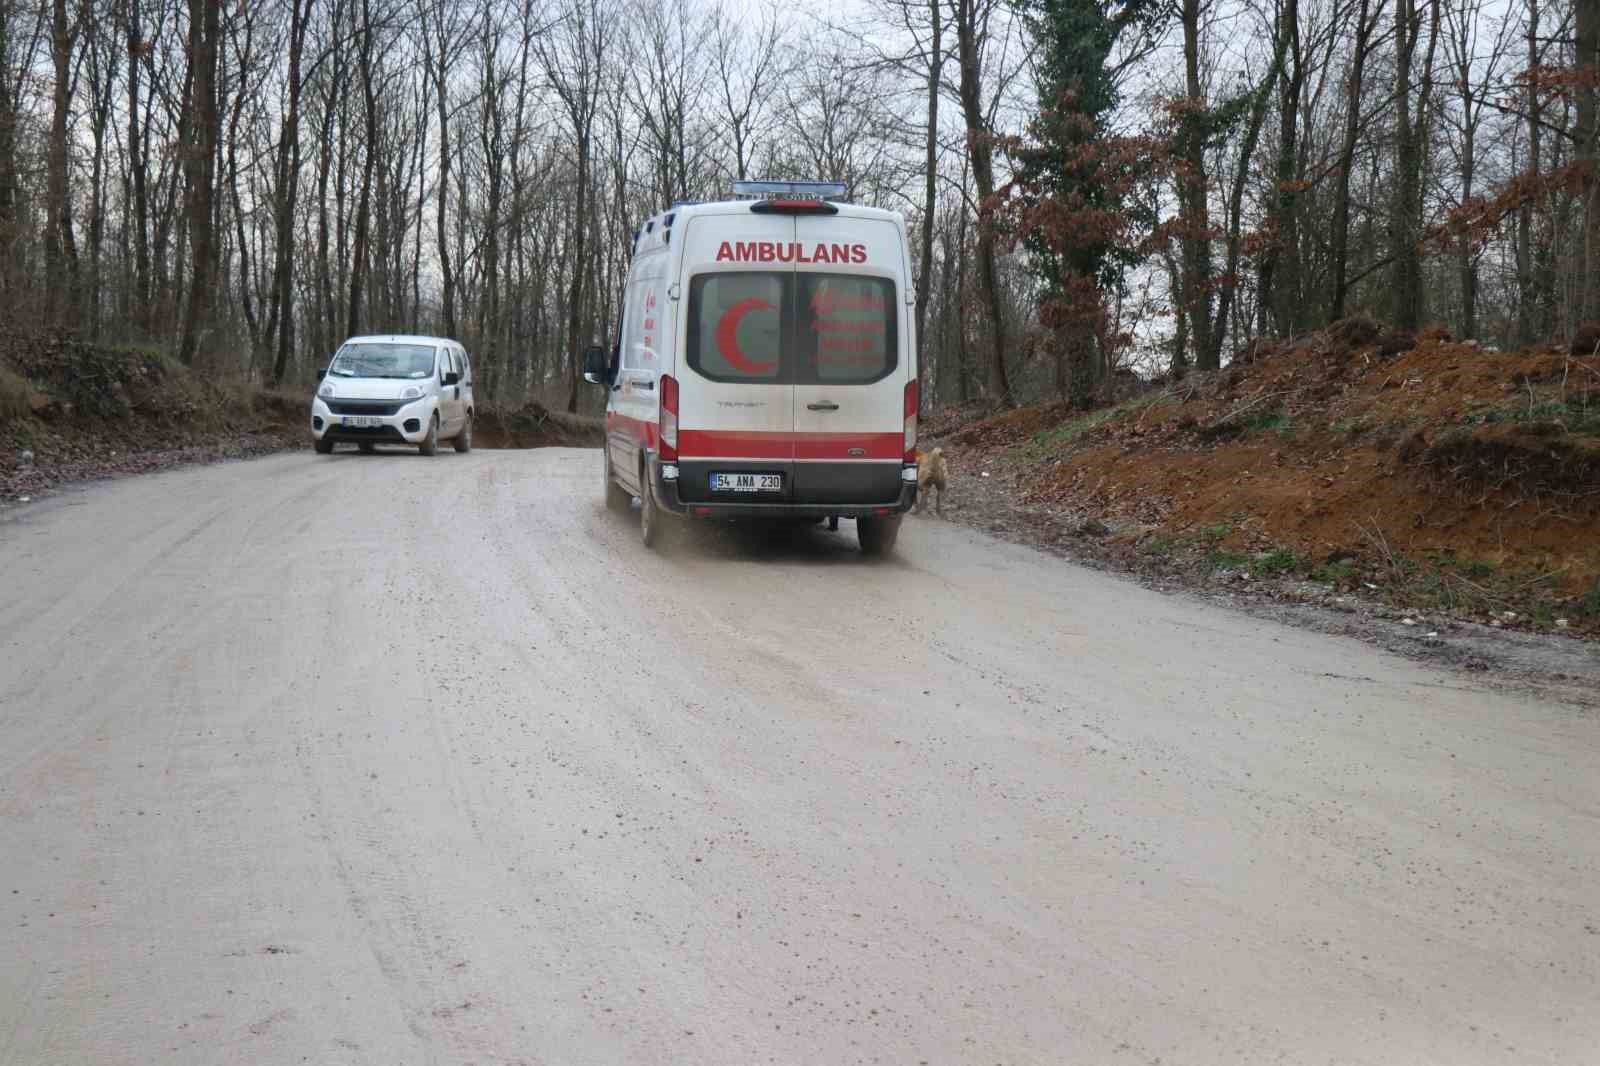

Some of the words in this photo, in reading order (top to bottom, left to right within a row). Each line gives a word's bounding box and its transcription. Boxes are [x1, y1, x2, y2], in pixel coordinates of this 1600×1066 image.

[716, 241, 867, 263] AMBULANS
[718, 475, 730, 486] 54
[736, 475, 754, 487] ANA
[760, 476, 780, 487] 230
